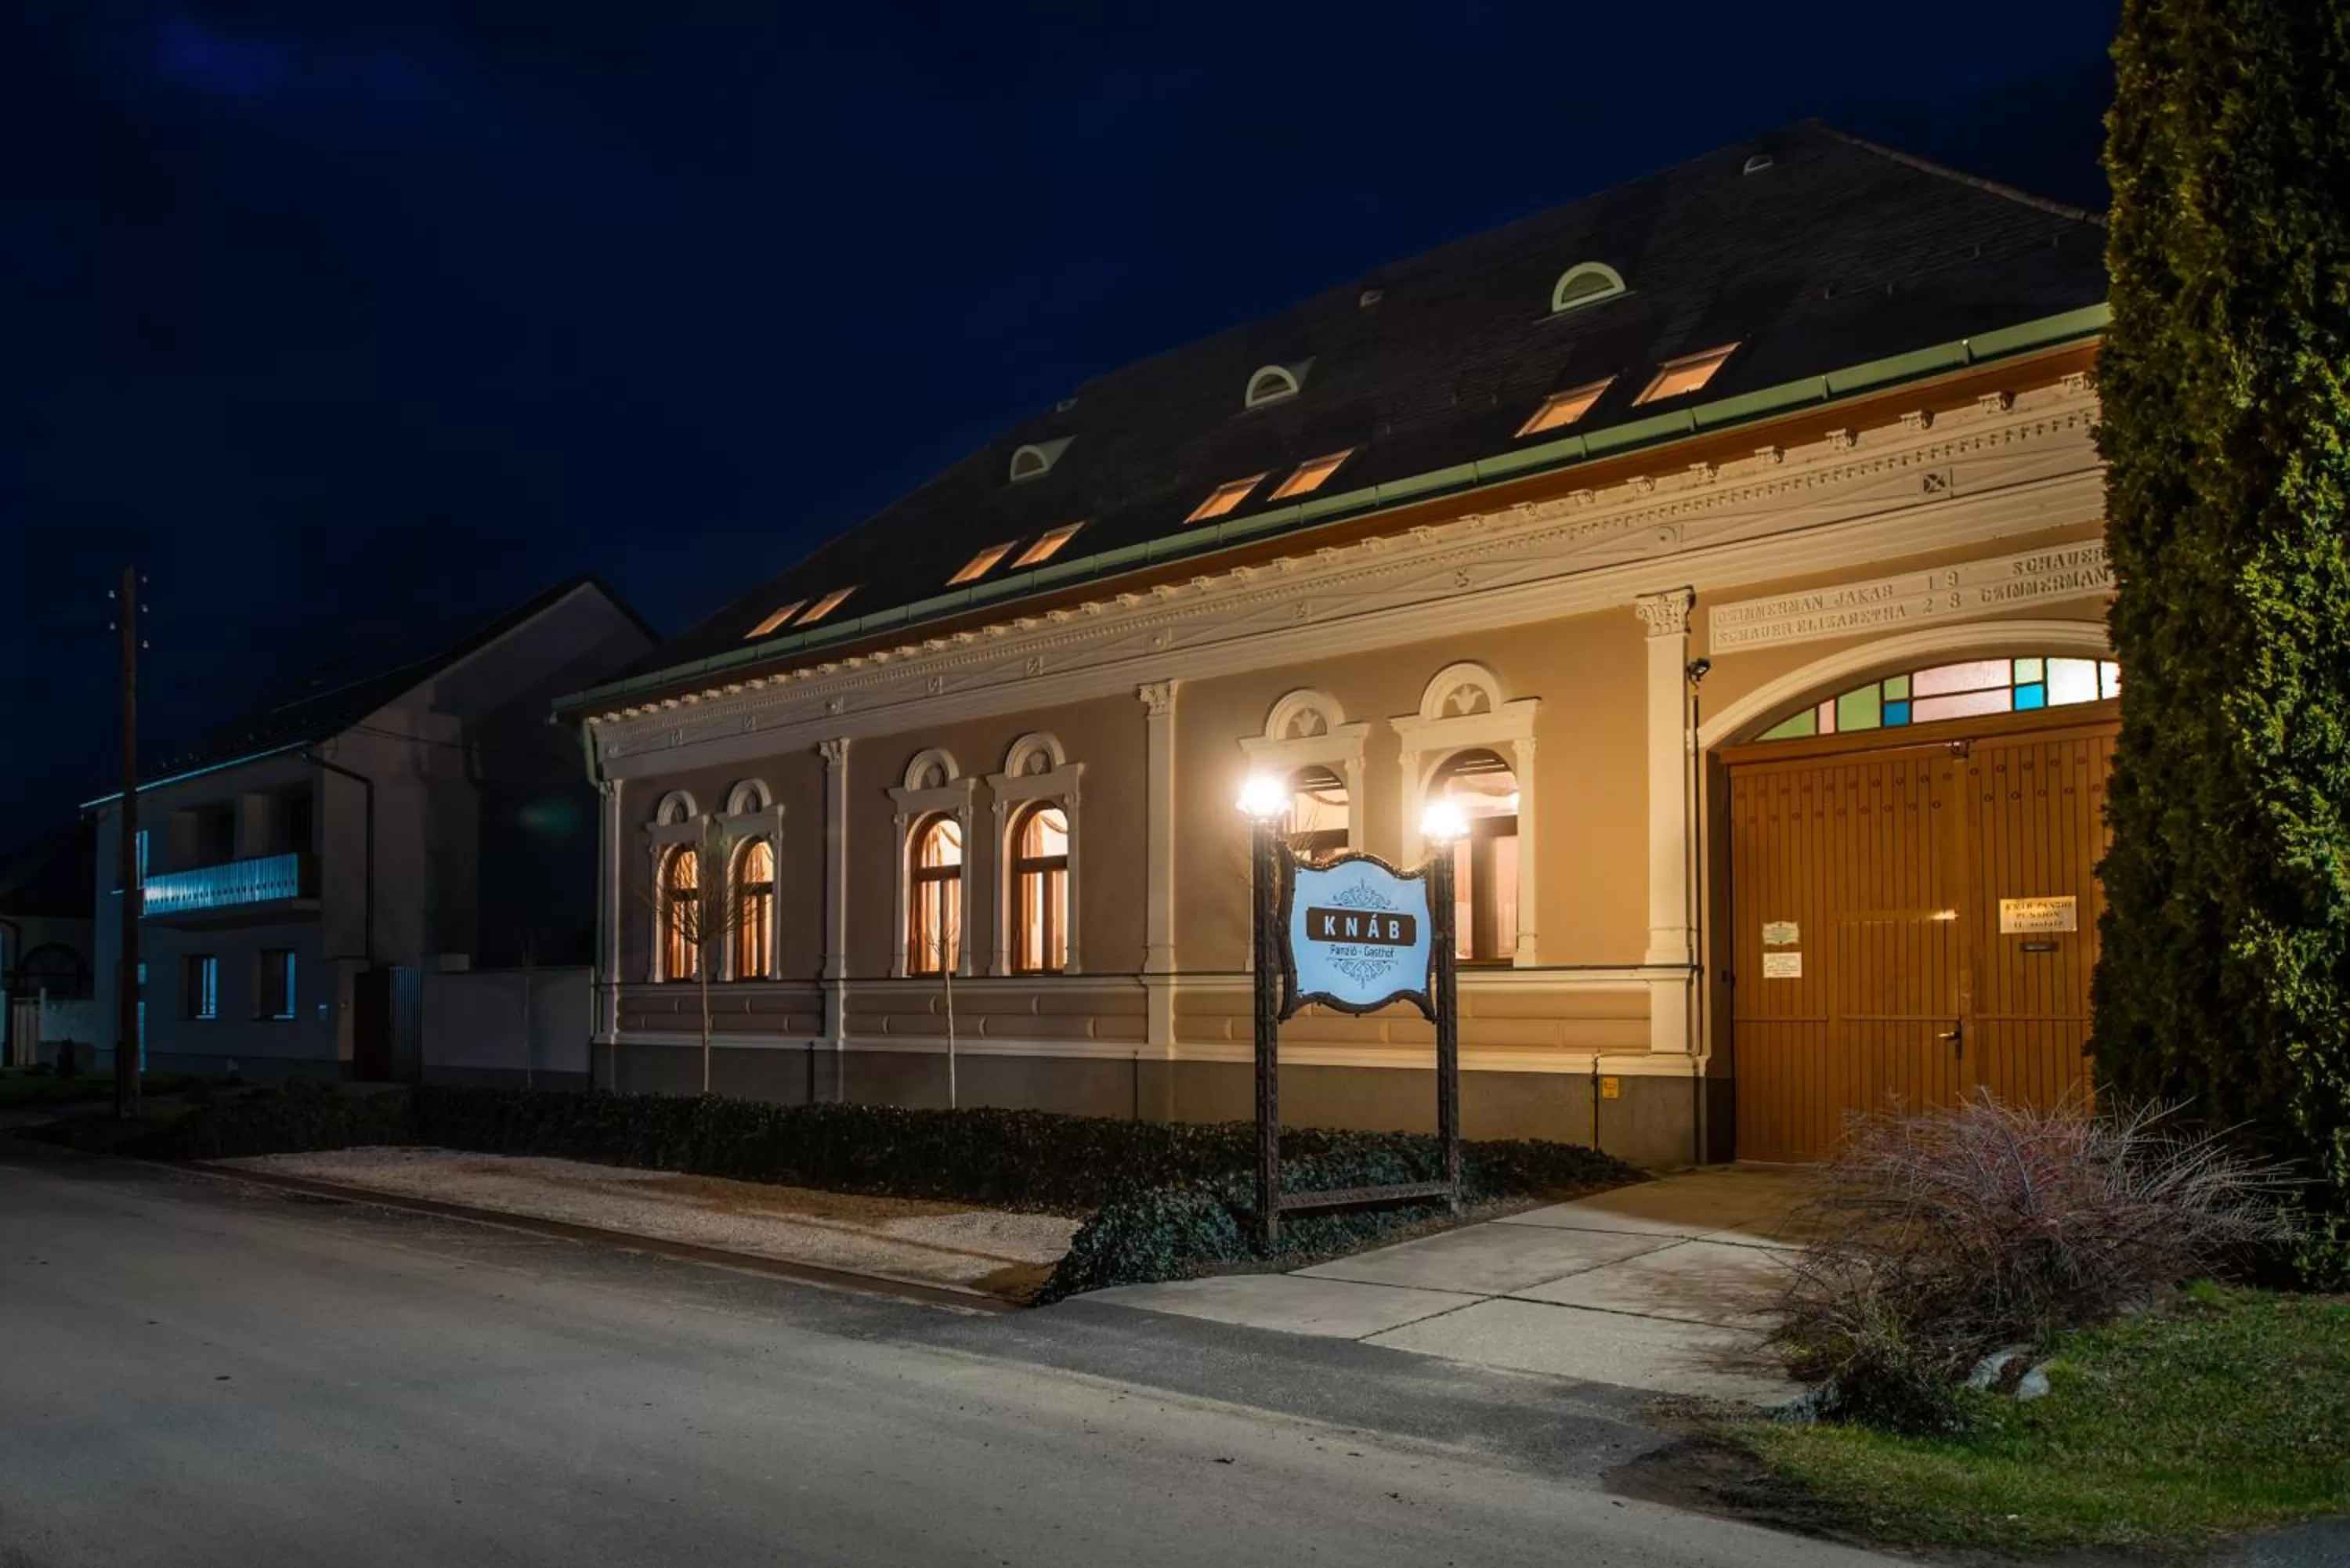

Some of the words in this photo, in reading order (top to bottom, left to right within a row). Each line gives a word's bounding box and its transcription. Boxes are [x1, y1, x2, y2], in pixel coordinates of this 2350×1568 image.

[1834, 584, 1893, 604] JAKAB
[1325, 914, 1400, 939] KNÁB
[1365, 945, 1394, 958] Gasthof
